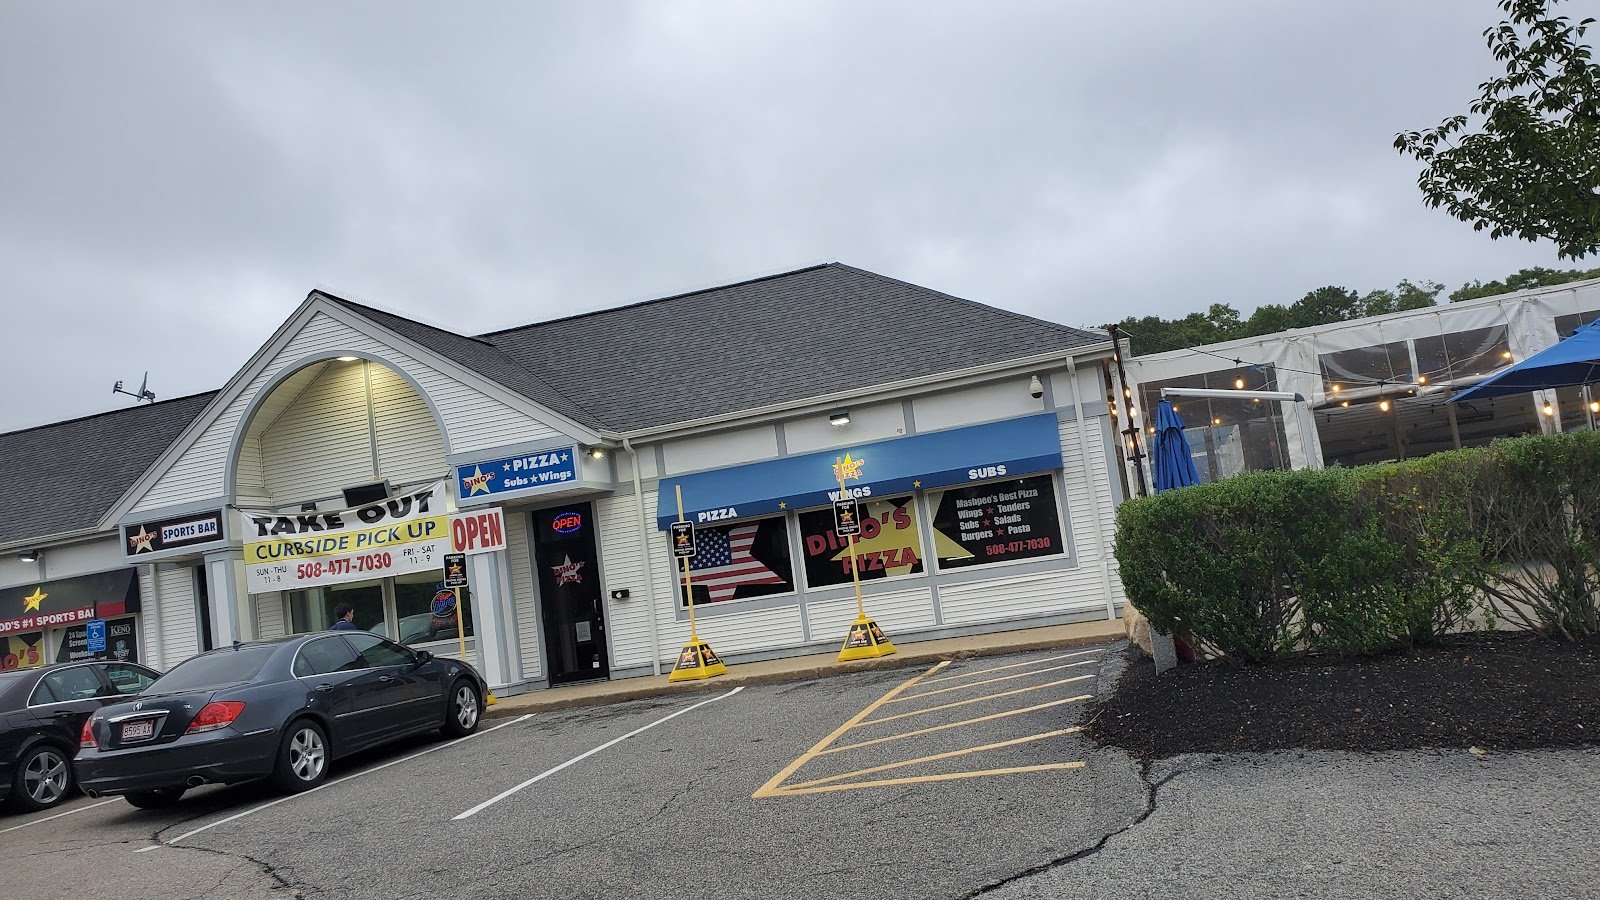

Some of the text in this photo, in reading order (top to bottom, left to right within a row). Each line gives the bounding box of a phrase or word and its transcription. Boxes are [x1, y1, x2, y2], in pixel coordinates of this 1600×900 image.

[512, 453, 560, 472] PIZZA
[833, 459, 865, 474] DNO'S
[464, 472, 495, 489] DINO'S
[504, 470, 572, 488] Subs Wings
[836, 469, 863, 480] PZZA
[968, 465, 1007, 480] SUBS
[828, 486, 872, 502] WNGS
[956, 489, 1038, 508] Mashpee's Best Pizza
[252, 490, 434, 537] TAKE OUT
[697, 507, 738, 522] PIZZA
[958, 501, 1031, 519] Wings Tenders
[552, 515, 581, 530] OPEN
[960, 514, 1022, 530] Subs Salads
[130, 531, 157, 547] DINO'S
[163, 522, 216, 540] SPORTS BAR
[453, 512, 503, 552] OPEN
[961, 524, 1031, 541] Burgers Pasta
[256, 521, 436, 559] CURBSIDE PICK UP
[986, 537, 1051, 556] 508-477-7030
[403, 548, 414, 556] FRI
[421, 545, 436, 553] SAT
[256, 568, 269, 576] SUN
[274, 566, 287, 574] THU
[297, 552, 392, 580] 508-477-7030
[22, 618, 34, 629] #1
[36, 611, 76, 626] SPORTS
[110, 624, 131, 636] KENO
